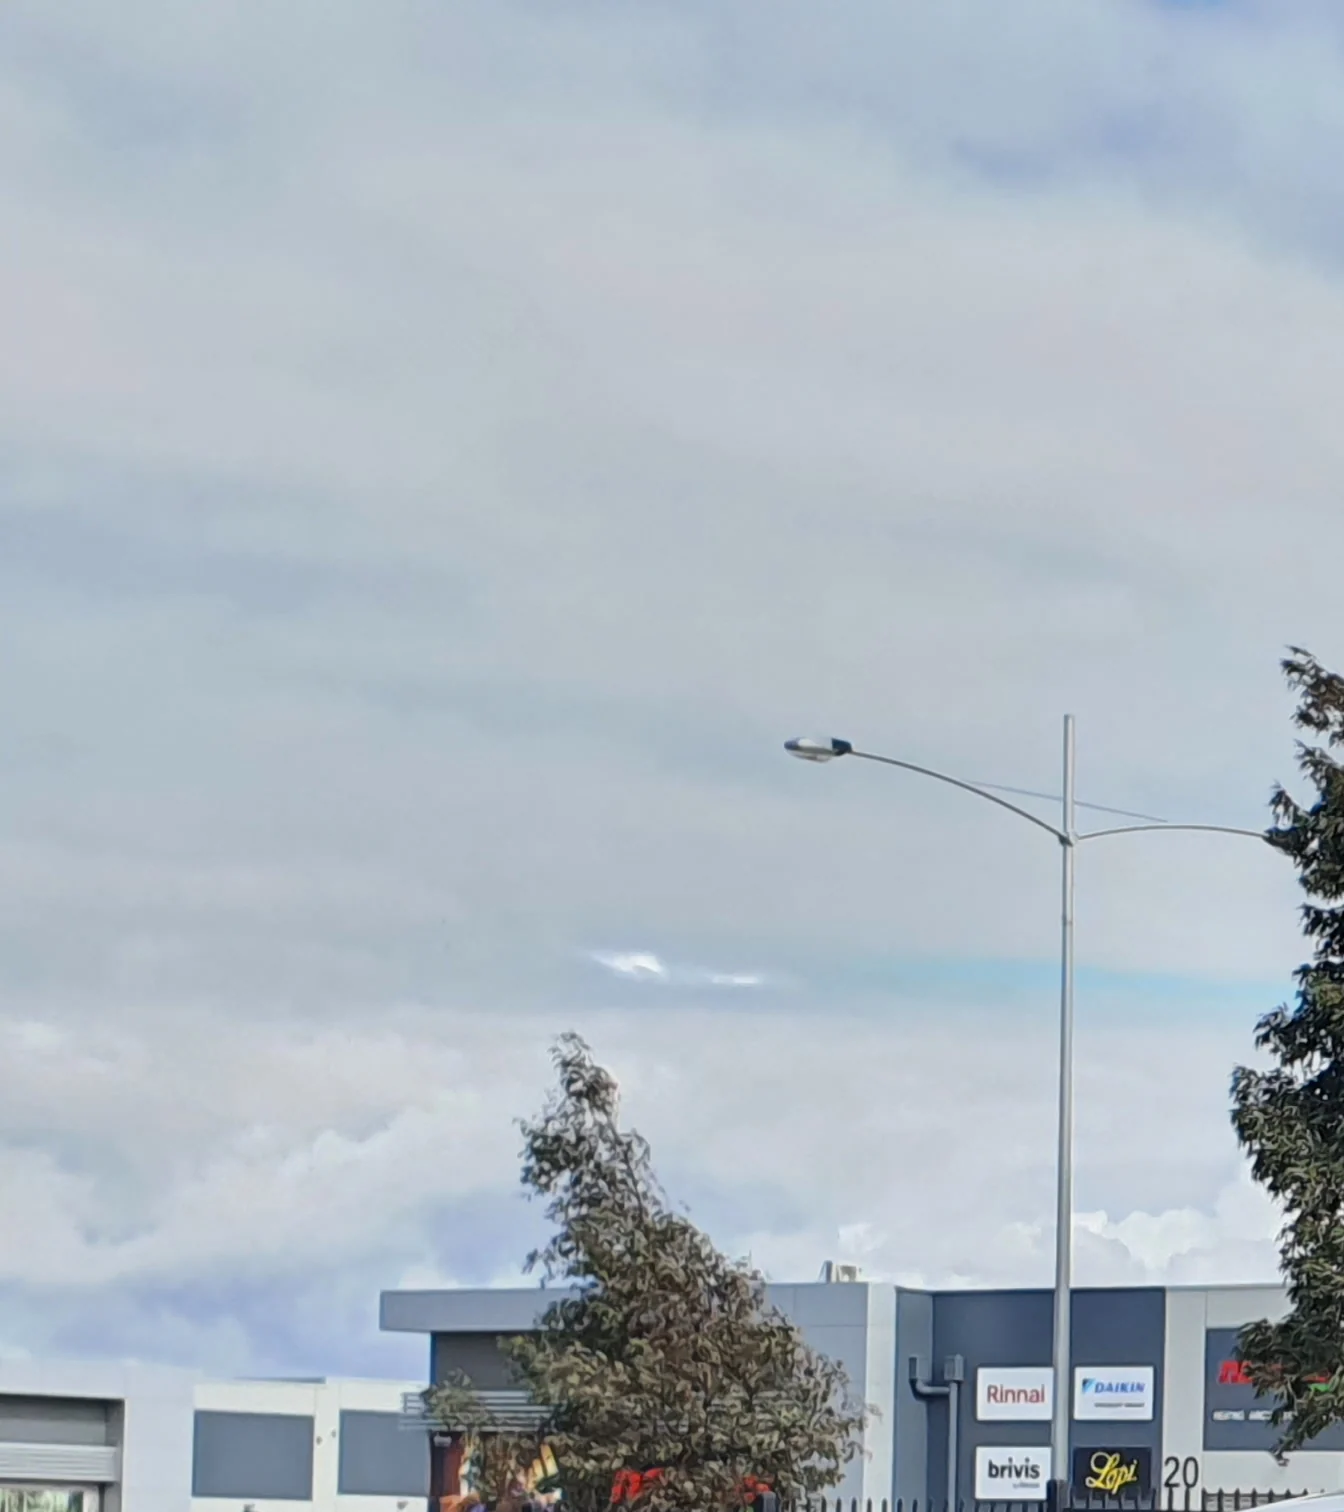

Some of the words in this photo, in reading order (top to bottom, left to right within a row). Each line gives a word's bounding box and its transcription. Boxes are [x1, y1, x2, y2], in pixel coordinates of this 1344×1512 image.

[987, 1384, 1045, 1404] Rinnai
[1094, 1380, 1146, 1394] DAIKIN
[988, 1456, 1041, 1480] brivis
[1163, 1455, 1200, 1489] 20
